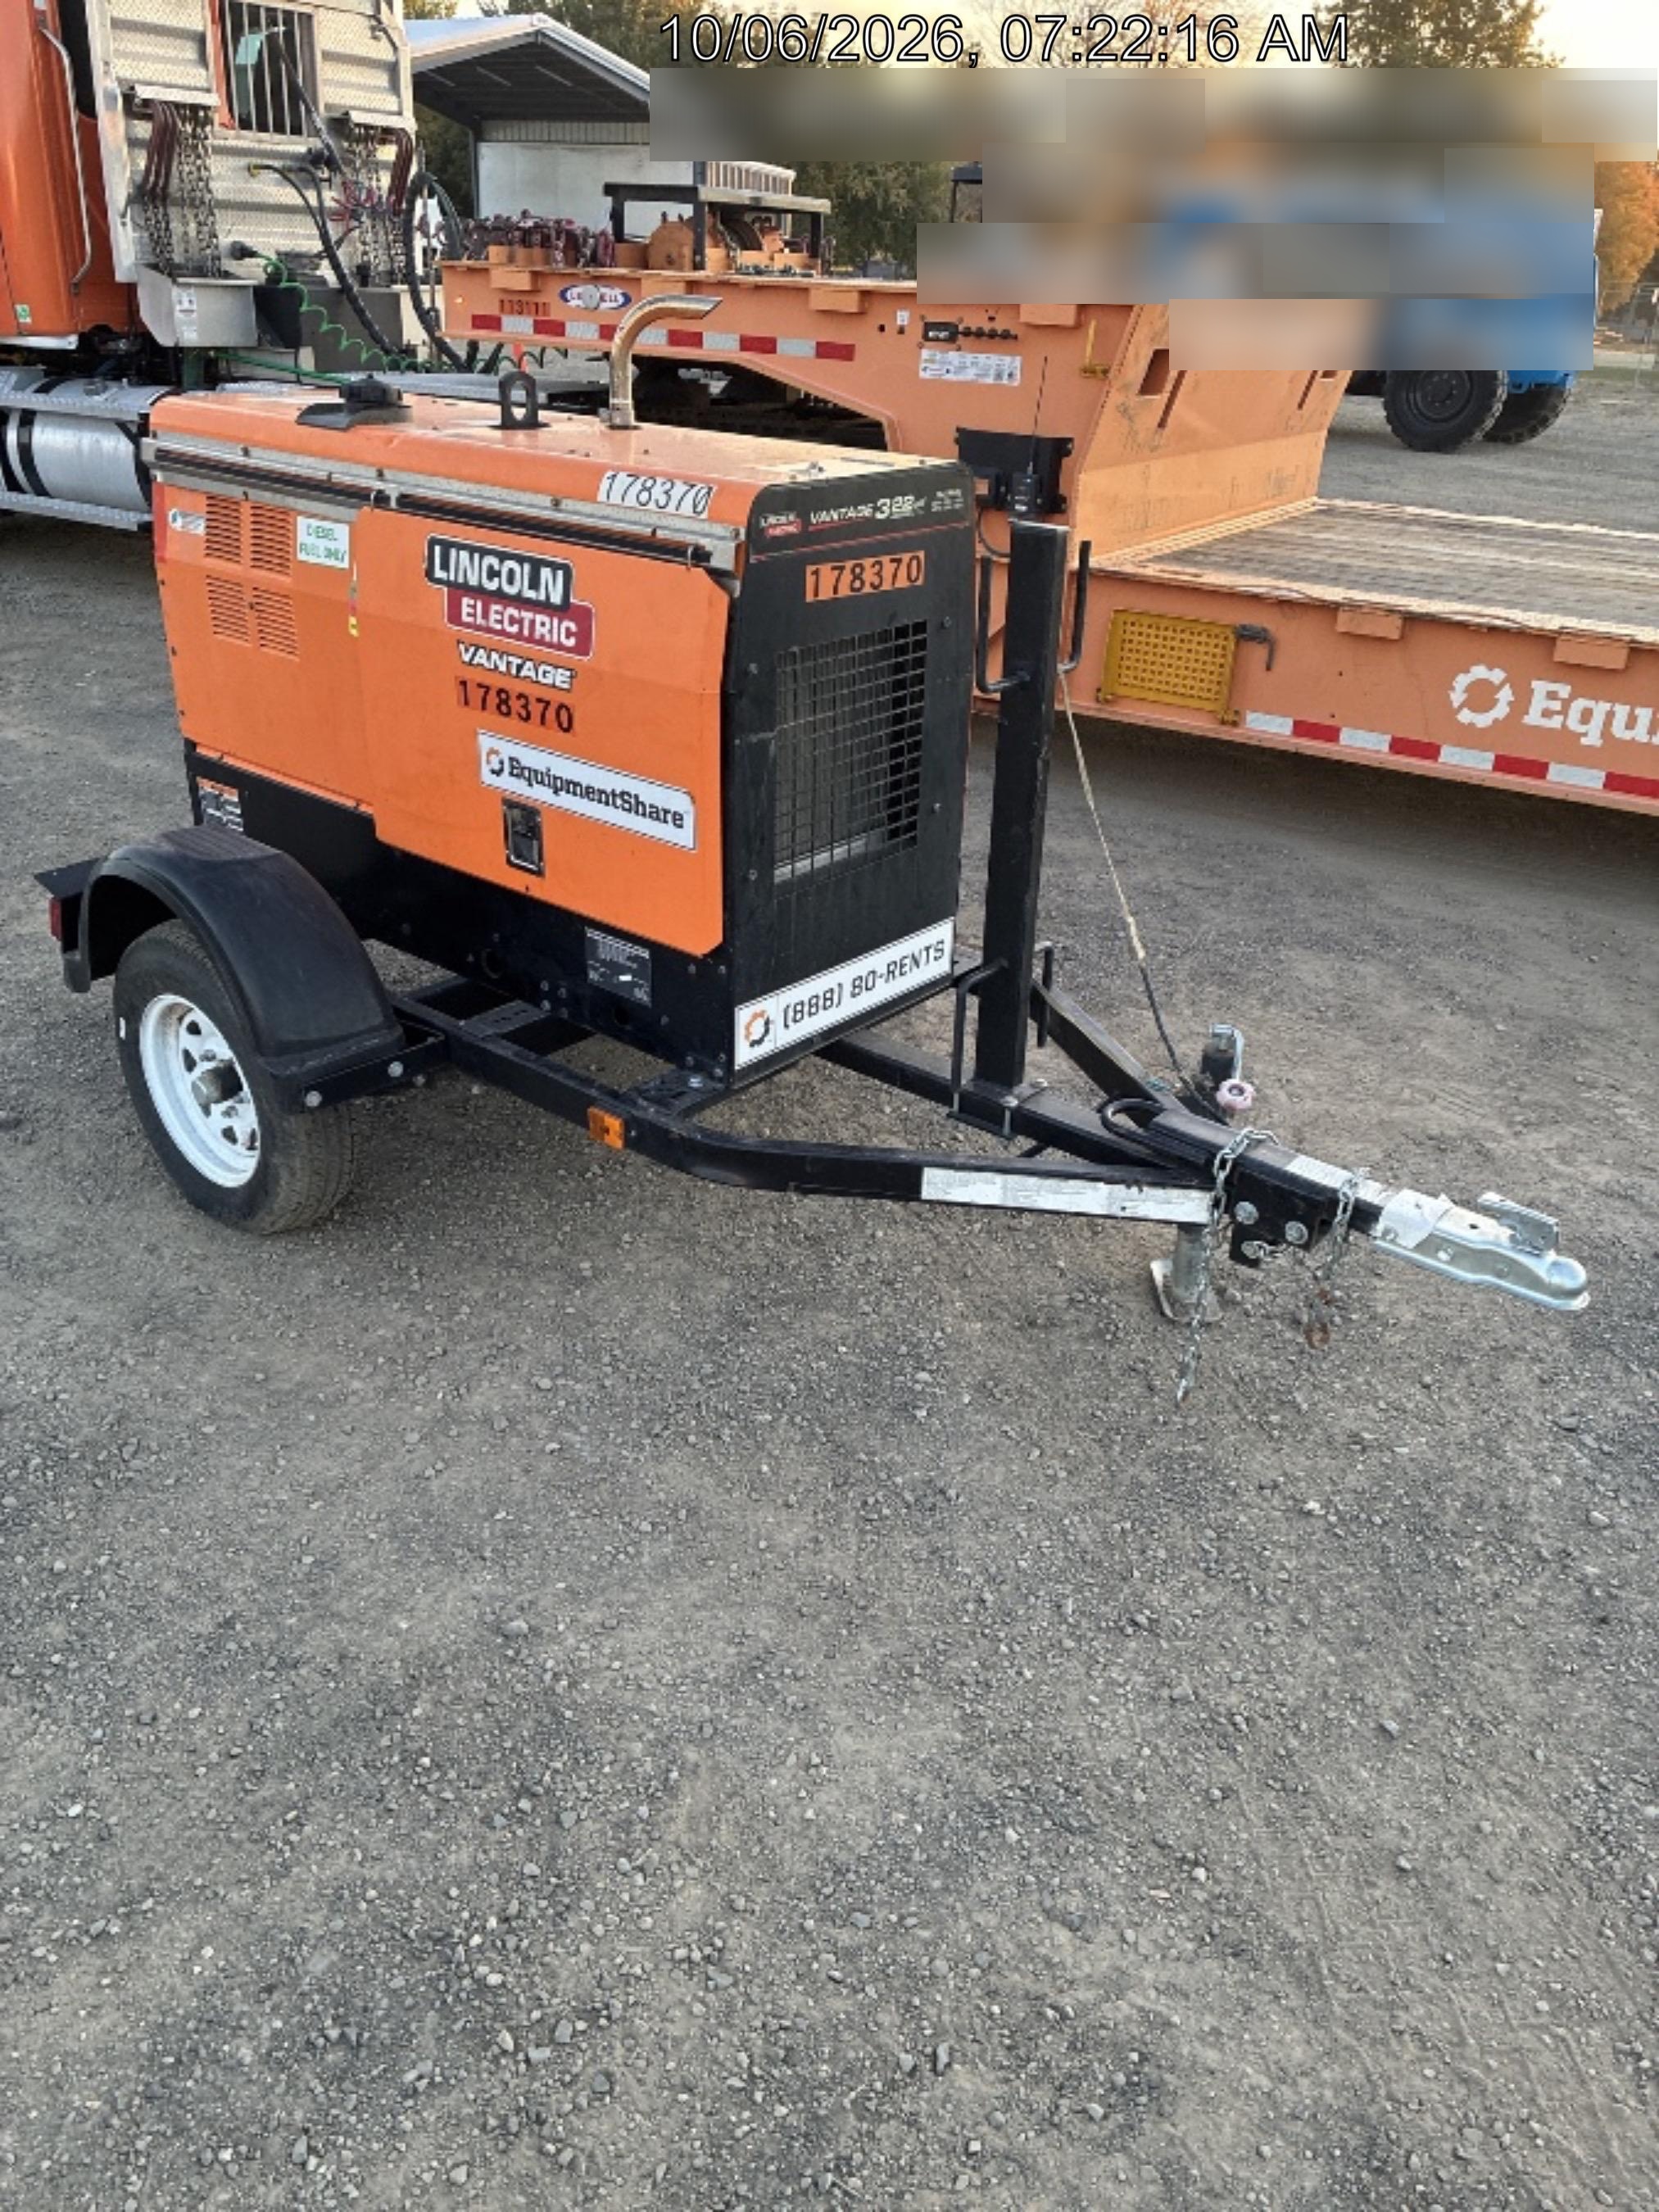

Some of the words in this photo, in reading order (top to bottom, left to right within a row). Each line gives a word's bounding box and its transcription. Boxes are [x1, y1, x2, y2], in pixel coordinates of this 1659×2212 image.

[606, 471, 714, 515] 178370
[433, 545, 564, 605] LINCOLN
[809, 554, 922, 599] 178370
[460, 596, 578, 648] ELECTRIC
[457, 641, 573, 691] VANTAGE
[458, 679, 574, 733] 178370
[508, 755, 685, 829] EquipmentShare
